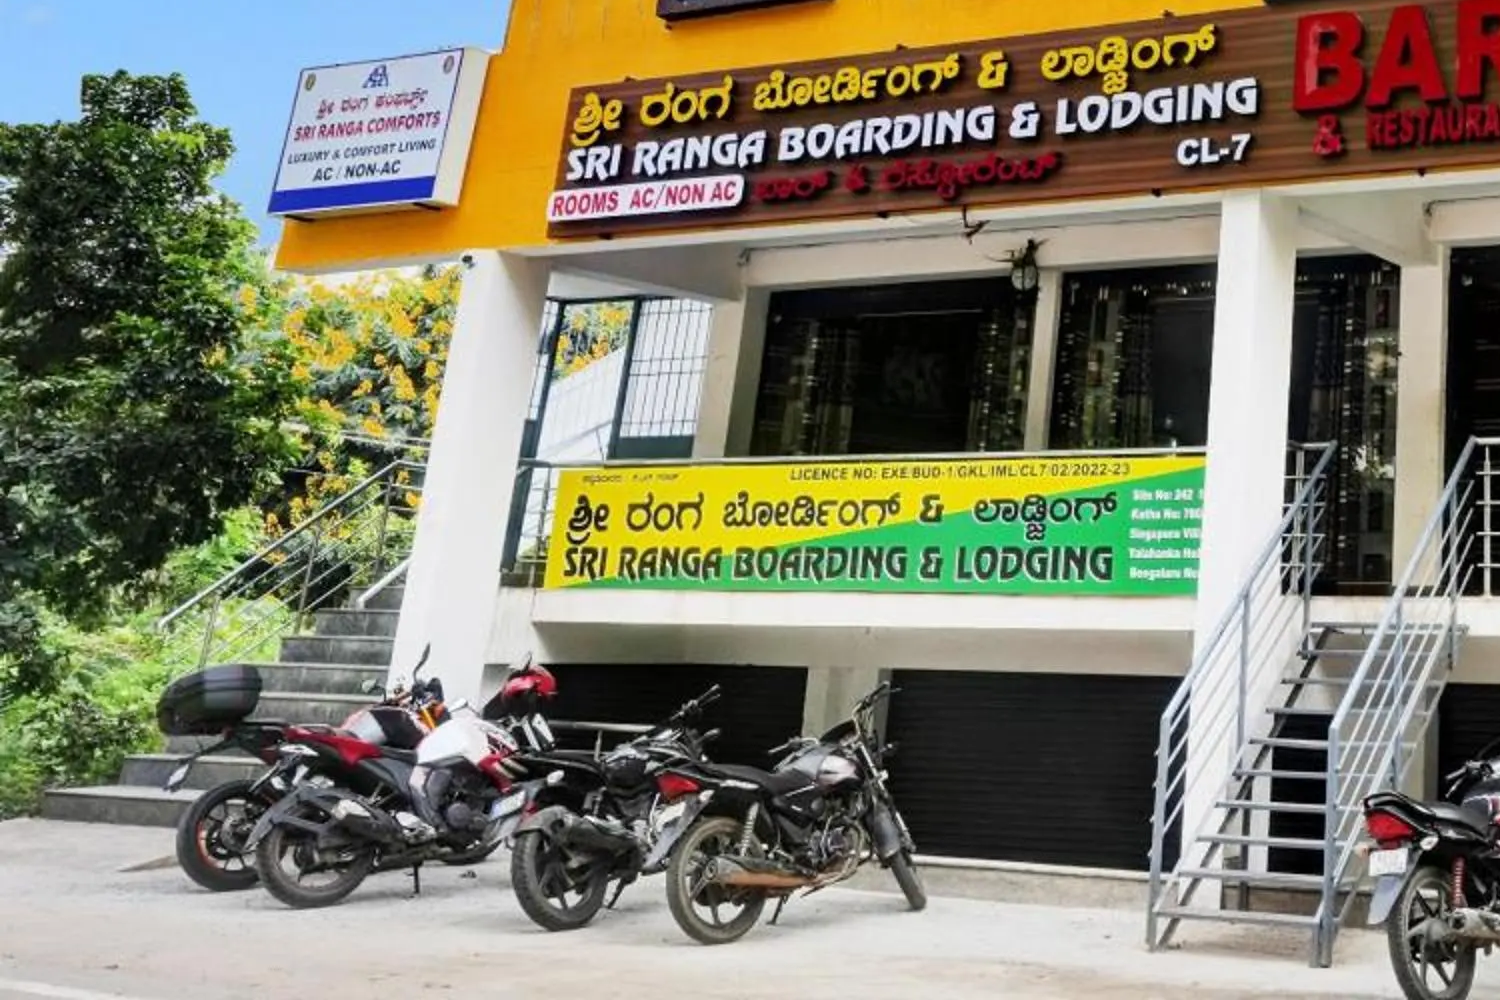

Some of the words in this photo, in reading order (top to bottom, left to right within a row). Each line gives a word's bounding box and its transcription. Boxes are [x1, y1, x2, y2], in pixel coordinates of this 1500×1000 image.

[570, 92, 623, 146] ಶ್ರೀ
[640, 75, 733, 127] ರಂಗ
[978, 49, 1008, 89] &
[294, 126, 315, 141] SRI
[318, 120, 363, 139] RANGA
[367, 111, 441, 133] COMFORTS
[566, 144, 623, 181] SRI
[632, 130, 767, 176] RANGA
[778, 105, 996, 161] BOARDING
[1009, 102, 1040, 138] &
[1055, 78, 1258, 135] LODGING
[1313, 114, 1344, 156] &
[288, 151, 329, 165] LUXURY
[332, 150, 340, 160] &
[344, 144, 395, 159] COMFORT
[398, 138, 436, 152] LIVING
[1177, 133, 1252, 167] CL-7
[313, 167, 332, 182] AC
[345, 160, 401, 179] NON-AC
[552, 192, 618, 216] ROOMS
[630, 183, 705, 209] AC/NON
[711, 181, 736, 202] AC
[790, 467, 848, 481] LICENCE
[853, 467, 877, 480] NO:
[566, 494, 610, 545] ಶ್ರೀ
[627, 492, 704, 531] ರಂಗ
[919, 494, 944, 523] &
[563, 547, 607, 581] SRI
[618, 546, 722, 583] RANGA
[732, 546, 907, 583] BOARDING
[919, 546, 944, 580] &
[955, 545, 1113, 582] LODGING
